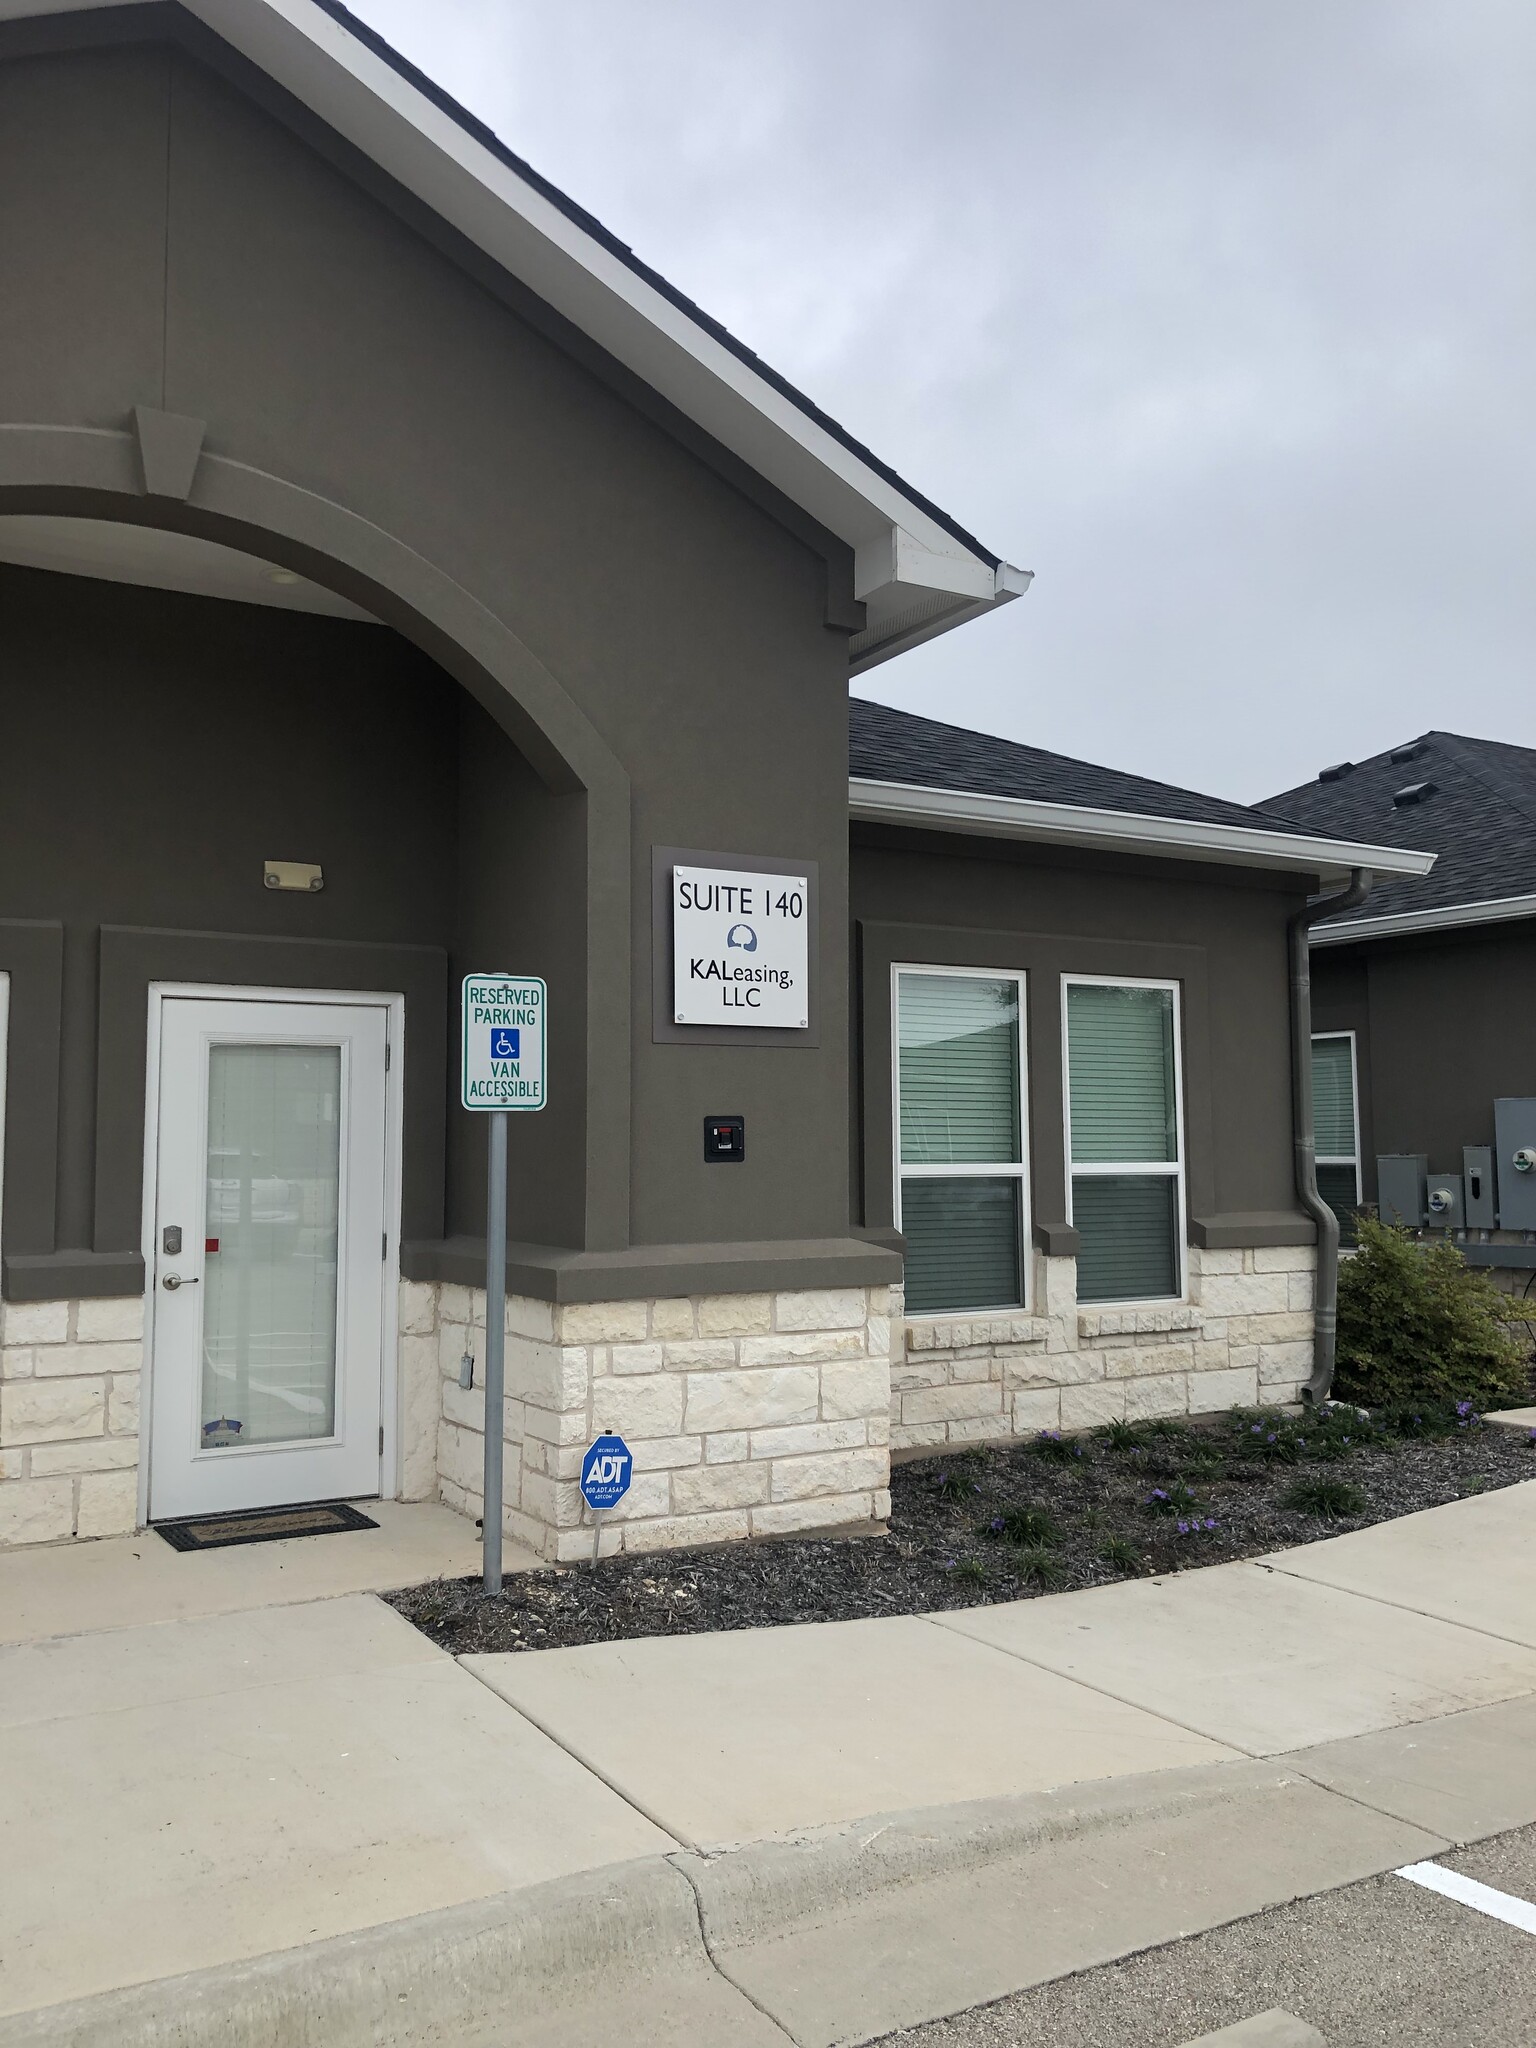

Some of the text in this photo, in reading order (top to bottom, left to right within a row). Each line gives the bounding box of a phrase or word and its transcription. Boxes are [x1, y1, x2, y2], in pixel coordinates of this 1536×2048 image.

[679, 882, 803, 919] SUITE 140
[690, 958, 794, 989] KALeasing,
[470, 987, 540, 1006] RESERVED
[723, 986, 761, 1007] LLC
[474, 1007, 536, 1026] PARKING
[490, 1061, 520, 1078] VAN
[469, 1080, 540, 1097] ACCESSIBLE
[585, 1455, 628, 1484] ADT
